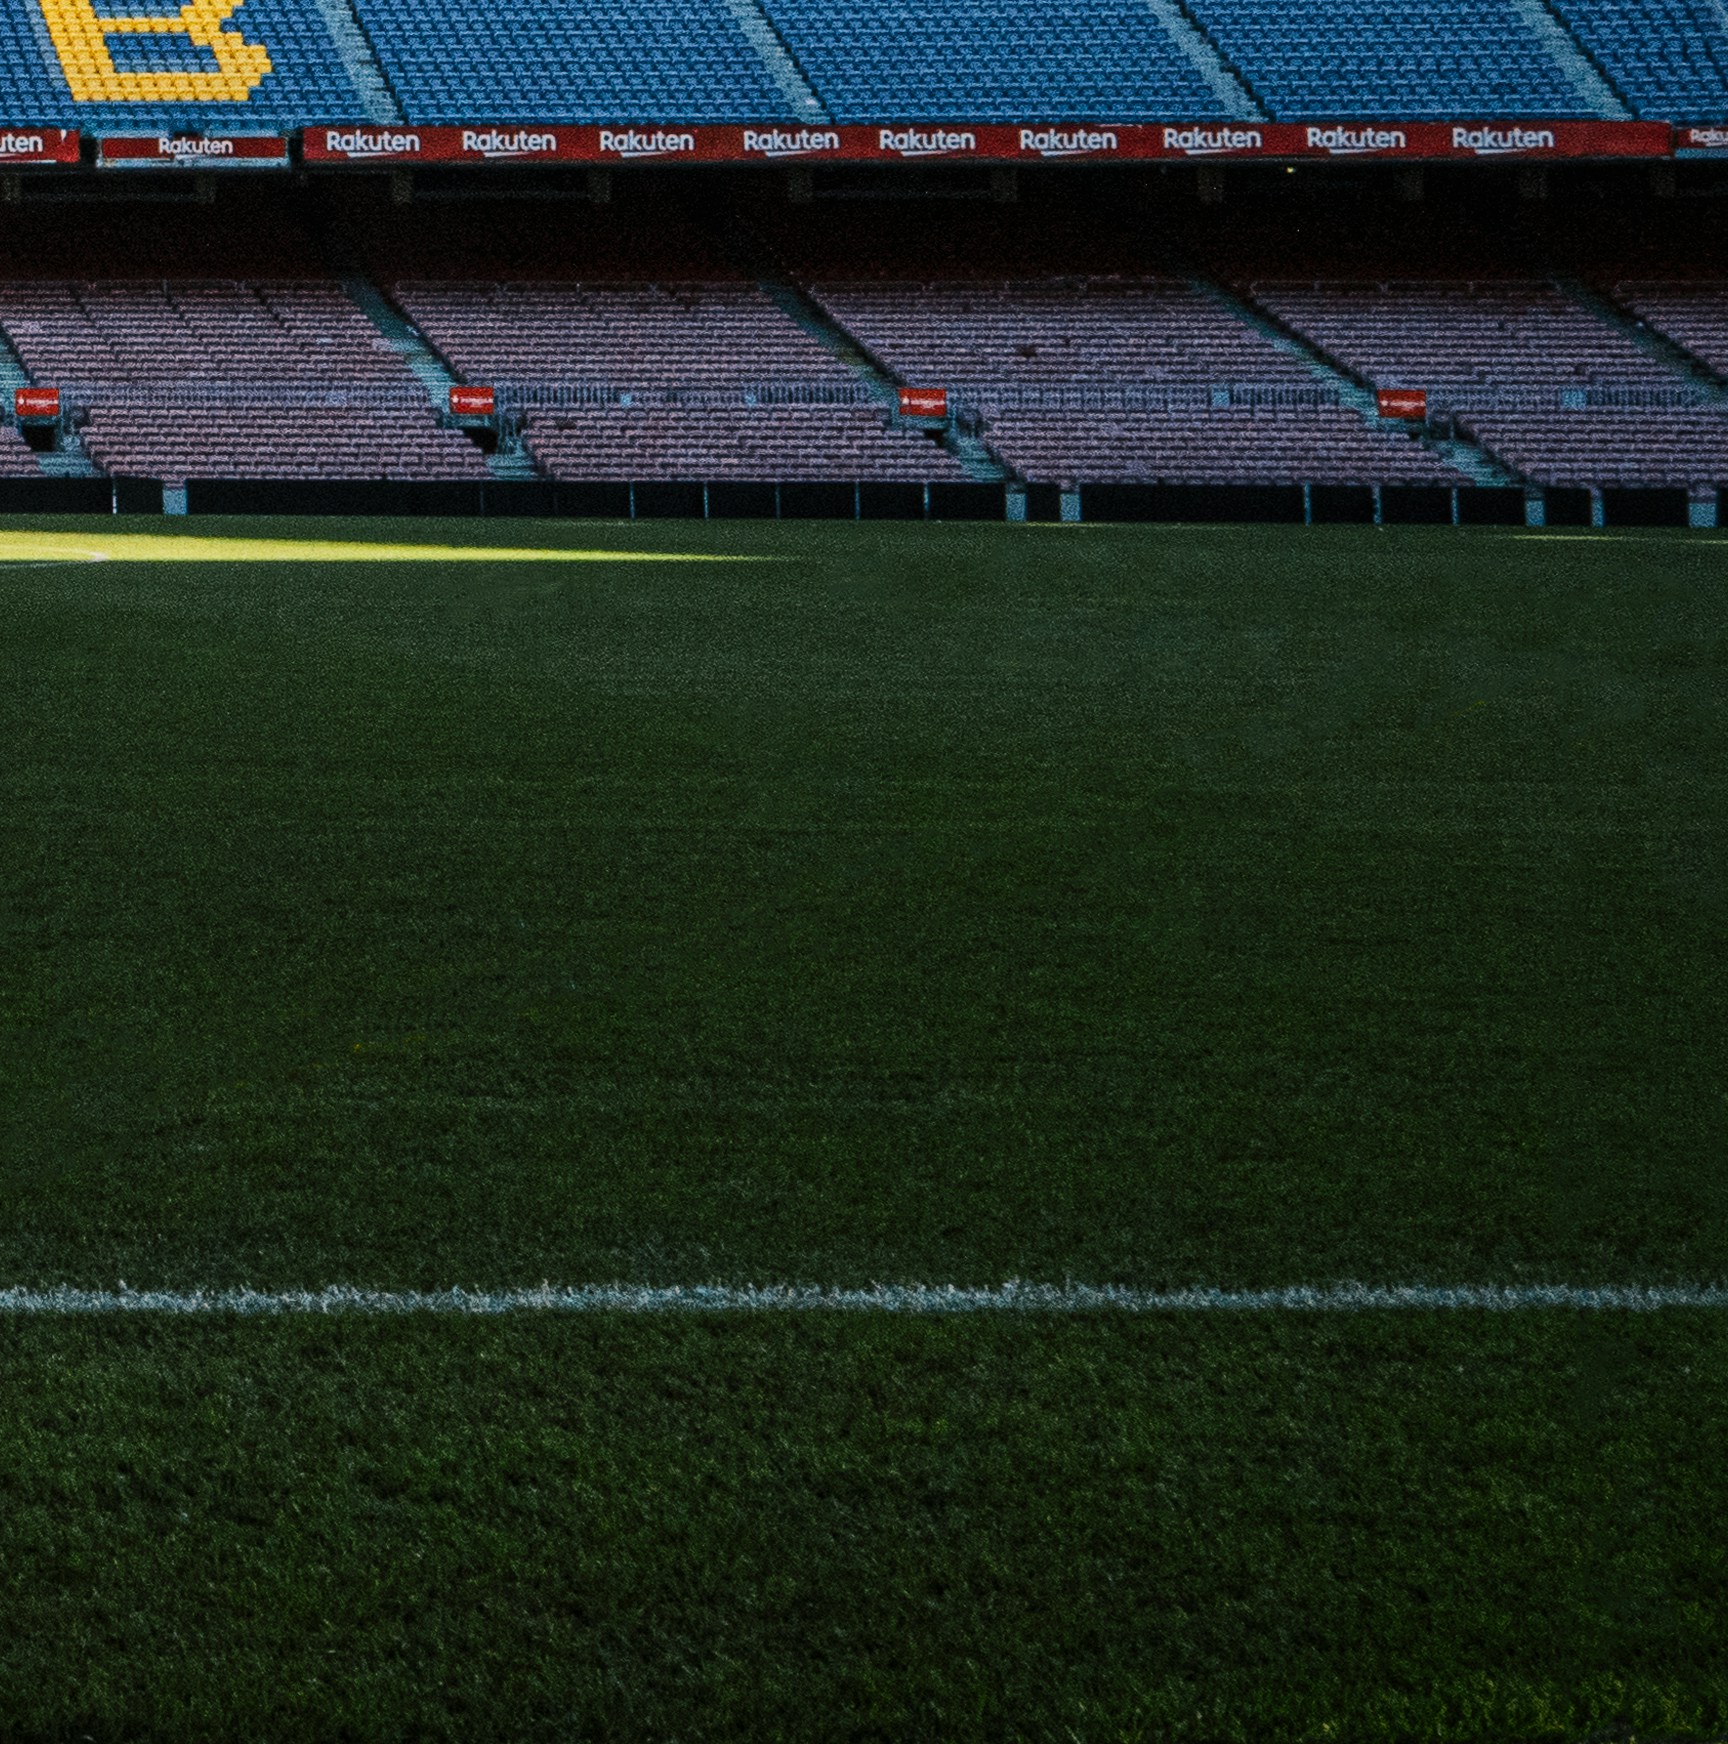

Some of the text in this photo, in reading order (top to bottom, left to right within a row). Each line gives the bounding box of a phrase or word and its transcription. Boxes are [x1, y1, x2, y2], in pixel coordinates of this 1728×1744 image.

[158, 136, 233, 154] Rakuten
[327, 131, 419, 151] Rakuten
[463, 131, 556, 151] Rakuten
[600, 131, 693, 151] Rakuten
[744, 131, 839, 151] Rakuten
[880, 130, 975, 150] Rakuten
[1020, 130, 1116, 150] Rakuten
[1164, 128, 1261, 148] Rakuten
[1307, 127, 1405, 147] Rakuten
[1453, 127, 1553, 147] Rakuten
